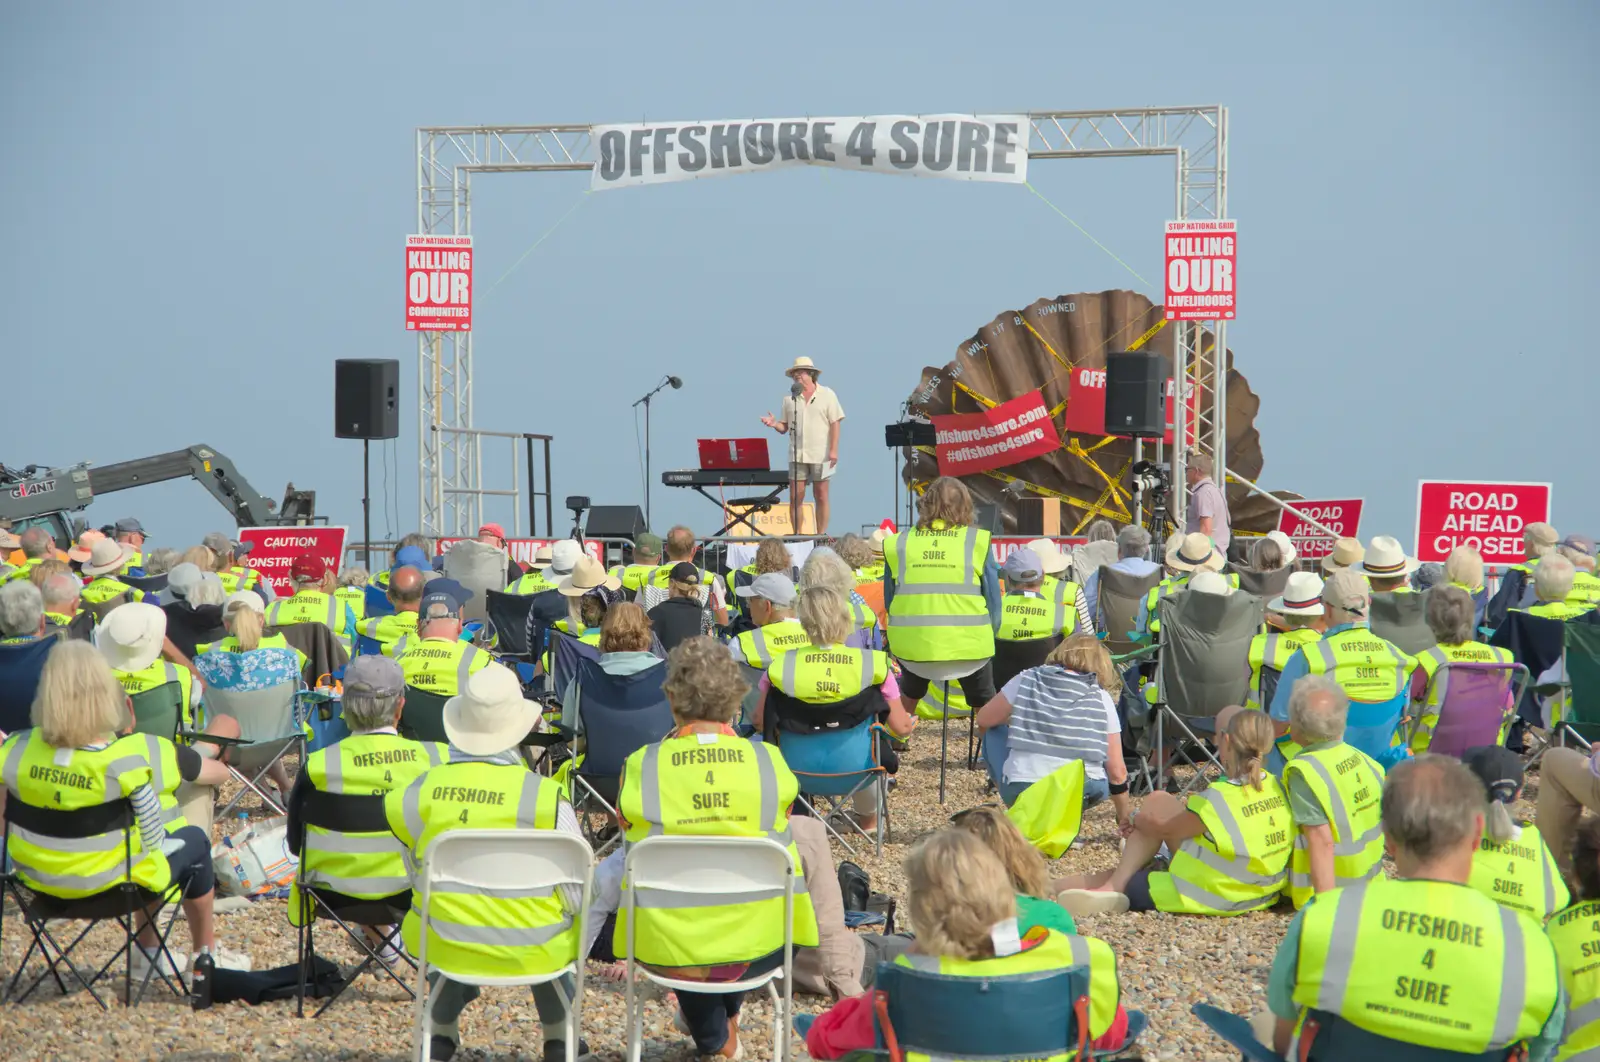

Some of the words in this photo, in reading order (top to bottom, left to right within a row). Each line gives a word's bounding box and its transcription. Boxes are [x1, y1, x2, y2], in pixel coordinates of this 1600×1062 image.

[600, 121, 836, 181] OFFSHORE
[845, 122, 876, 166] 4
[888, 120, 1019, 174] SURE
[1168, 222, 1185, 230] STOP
[1186, 222, 1217, 230] NATIONAL
[456, 237, 471, 245] GRID
[1168, 236, 1234, 256] KILLING
[408, 251, 470, 270] KILLING
[1169, 258, 1232, 293] OUR
[409, 271, 469, 304] OUR
[1168, 295, 1233, 307] LIVELIHOODS
[408, 306, 469, 317] COMMUNITIES
[920, 375, 942, 404] VOICES
[948, 363, 964, 379] HA
[967, 340, 988, 357] WILL
[1080, 369, 1106, 388] OFF
[946, 427, 1045, 463] #offshore4sure
[1449, 492, 1518, 511] ROAD
[1299, 506, 1343, 521] ROAD
[1292, 522, 1344, 536] AHEAD
[1442, 514, 1524, 533] AHEAD
[915, 528, 959, 538] OFFSHORE
[264, 537, 318, 548] CAUTION
[1290, 539, 1334, 552] CLOSE
[923, 551, 946, 560] SURE
[287, 595, 322, 605] OFFSHORE
[1006, 604, 1047, 616] OFFSHORE
[1021, 618, 1027, 626] 4
[773, 633, 810, 645] OFFSHO
[1012, 629, 1034, 638] SURE
[1340, 641, 1384, 652] OFFSHORE
[805, 653, 853, 665] OFFSHORE
[825, 667, 832, 677] 4
[1356, 666, 1380, 678] SURE
[412, 674, 437, 685] SURE
[816, 681, 840, 694] SURE
[353, 749, 417, 767] OFFSHORE
[672, 748, 745, 766] OFFSHORE
[29, 764, 94, 790] OFFSHORE
[383, 770, 393, 783] 4
[705, 770, 715, 785] 4
[53, 791, 61, 804] 4
[432, 786, 506, 806] OFFSHORE
[692, 792, 730, 810] SURE
[1242, 795, 1285, 818] OFFSHORE
[459, 809, 469, 824] 4
[1269, 816, 1275, 827] 4
[1264, 830, 1286, 847] SURE
[1507, 861, 1515, 875] 4
[1493, 878, 1523, 897] SURE
[1381, 908, 1484, 948] OFFSHORE
[1421, 948, 1436, 970] 4
[1395, 975, 1451, 1006] SURE
